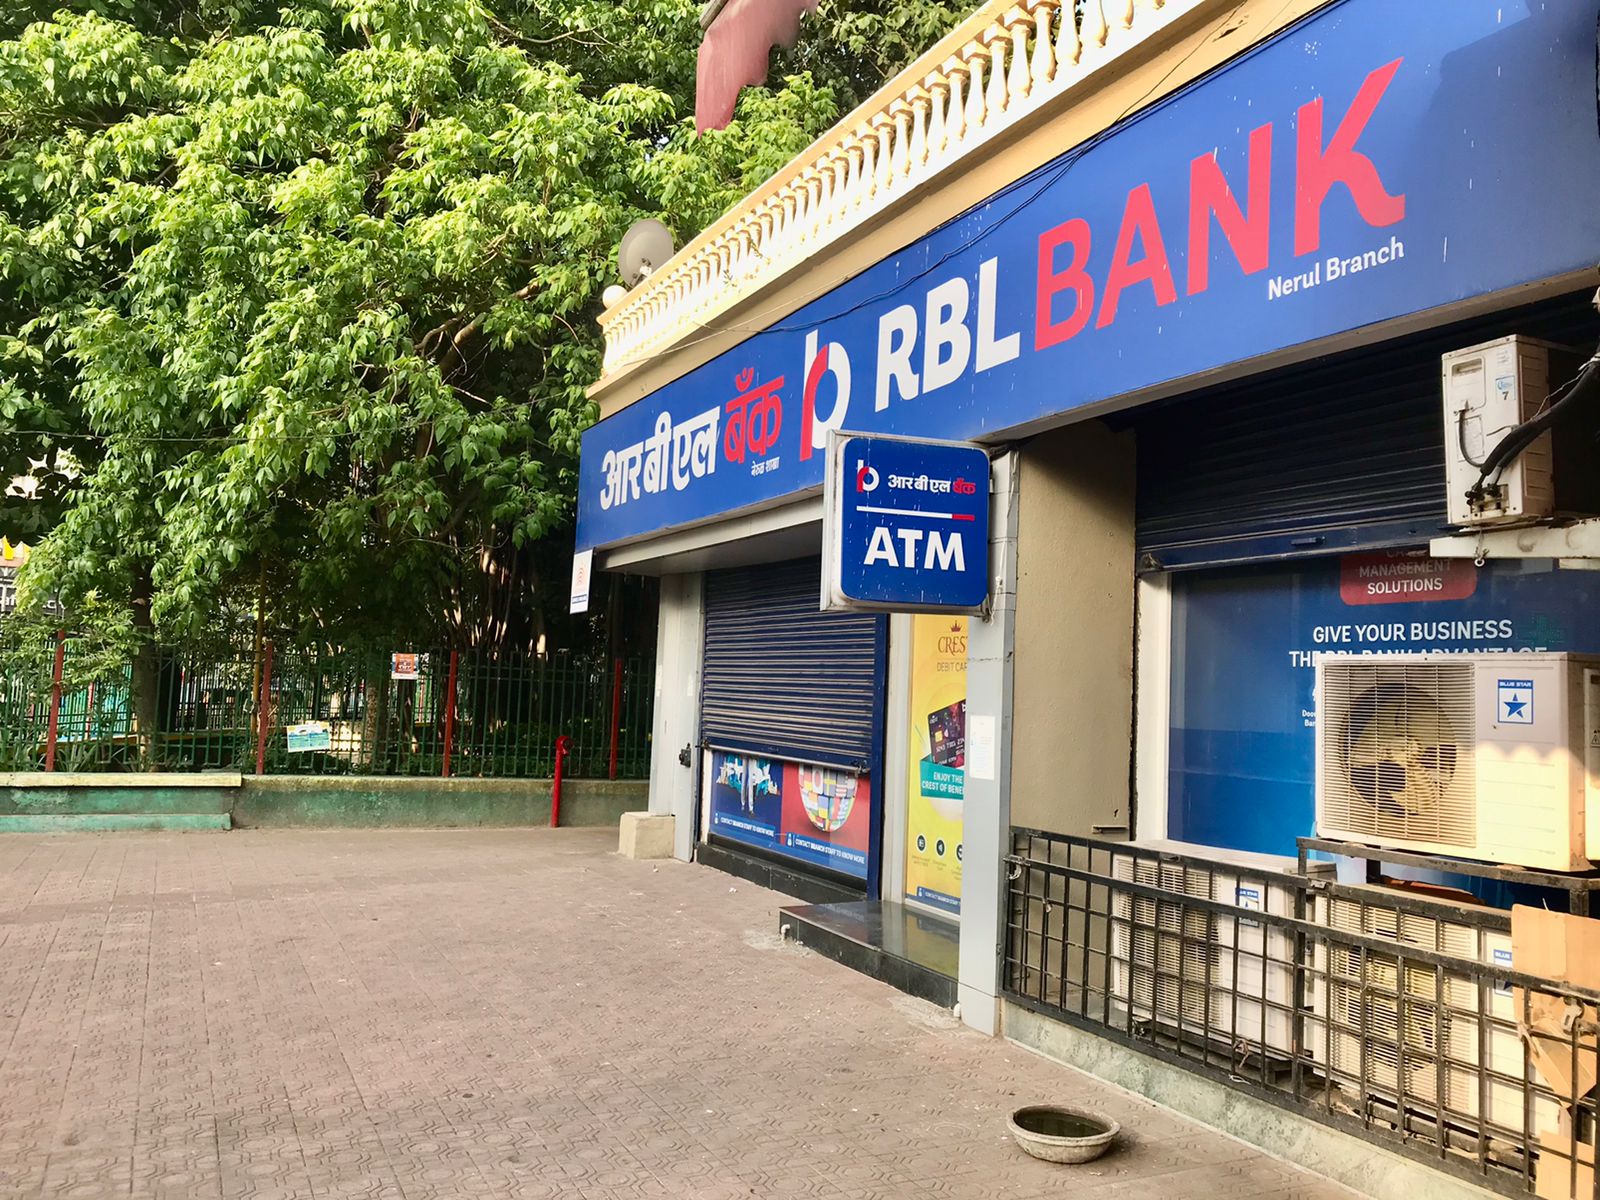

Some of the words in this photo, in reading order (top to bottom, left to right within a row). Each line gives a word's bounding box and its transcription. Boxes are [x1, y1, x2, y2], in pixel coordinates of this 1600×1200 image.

[875, 256, 1020, 413] RBL
[1034, 56, 1406, 352] BANK
[1268, 262, 1321, 300] Nerul
[1326, 236, 1405, 281] Branch
[600, 406, 721, 511] आरबीएल
[724, 367, 785, 464] बँक
[863, 526, 966, 572] ATM
[1360, 560, 1451, 578] MANAGEMENT
[1367, 578, 1443, 595] SOLUTIONS
[1313, 625, 1351, 643] GIVE
[1355, 623, 1406, 642] YOUR
[1410, 619, 1513, 641] BUSINESS
[937, 635, 968, 656] CRES
[937, 661, 955, 672] DEBIT
[922, 780, 939, 791] CREST
[940, 783, 948, 792] OF
[934, 771, 951, 782] ENJOY
[952, 774, 964, 784] THE
[795, 838, 811, 849] CONTACT
[811, 842, 825, 853] BRANCH
[824, 846, 836, 856] STAFF
[836, 849, 842, 857] TO
[841, 851, 854, 861] KNOW
[853, 854, 865, 865] MORE
[1495, 951, 1510, 959] BLUE
